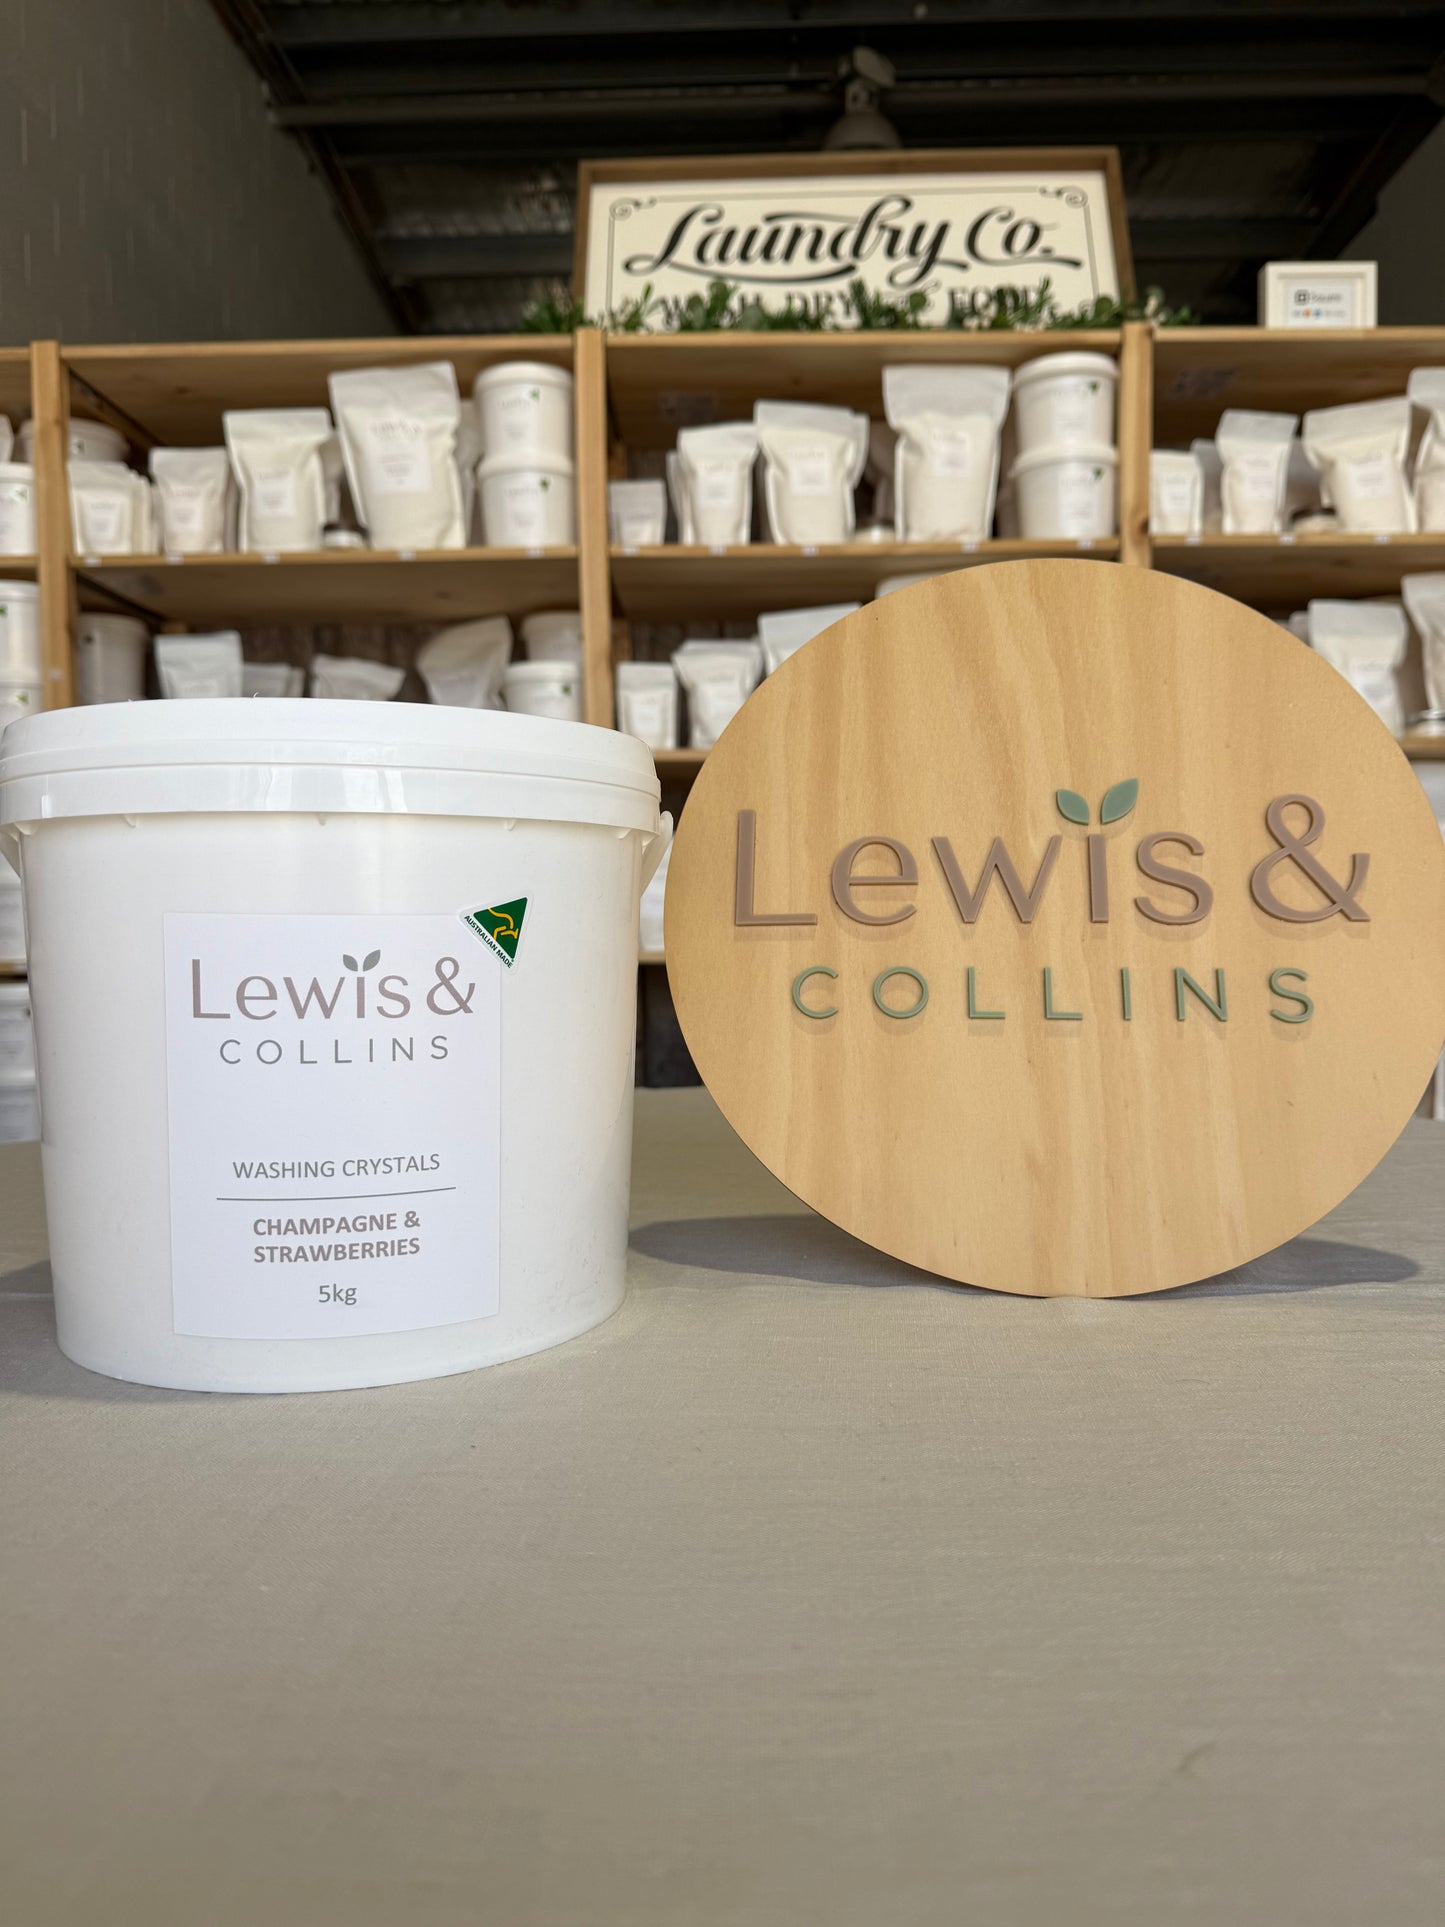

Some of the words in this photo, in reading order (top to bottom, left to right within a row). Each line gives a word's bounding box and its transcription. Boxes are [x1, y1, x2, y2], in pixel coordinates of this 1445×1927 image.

[624, 194, 968, 289] Laundry
[965, 204, 1082, 269] Co.
[734, 777, 1215, 928] Lewis
[1248, 794, 1371, 924] &
[464, 915, 498, 952] AUSTRALIAN
[495, 948, 514, 969] MADE
[191, 949, 411, 1020] Lewis
[426, 956, 476, 1016] &
[791, 964, 1315, 1025] COLLINS
[219, 1035, 449, 1065] COLLINS
[232, 1160, 336, 1180] WASHING
[342, 1153, 441, 1177] CRYSTALS
[253, 1212, 398, 1237] CHAMPAGNE
[403, 1210, 421, 1229] &
[253, 1237, 421, 1264] STRAWBERRIES
[318, 1283, 358, 1306] 5kg
